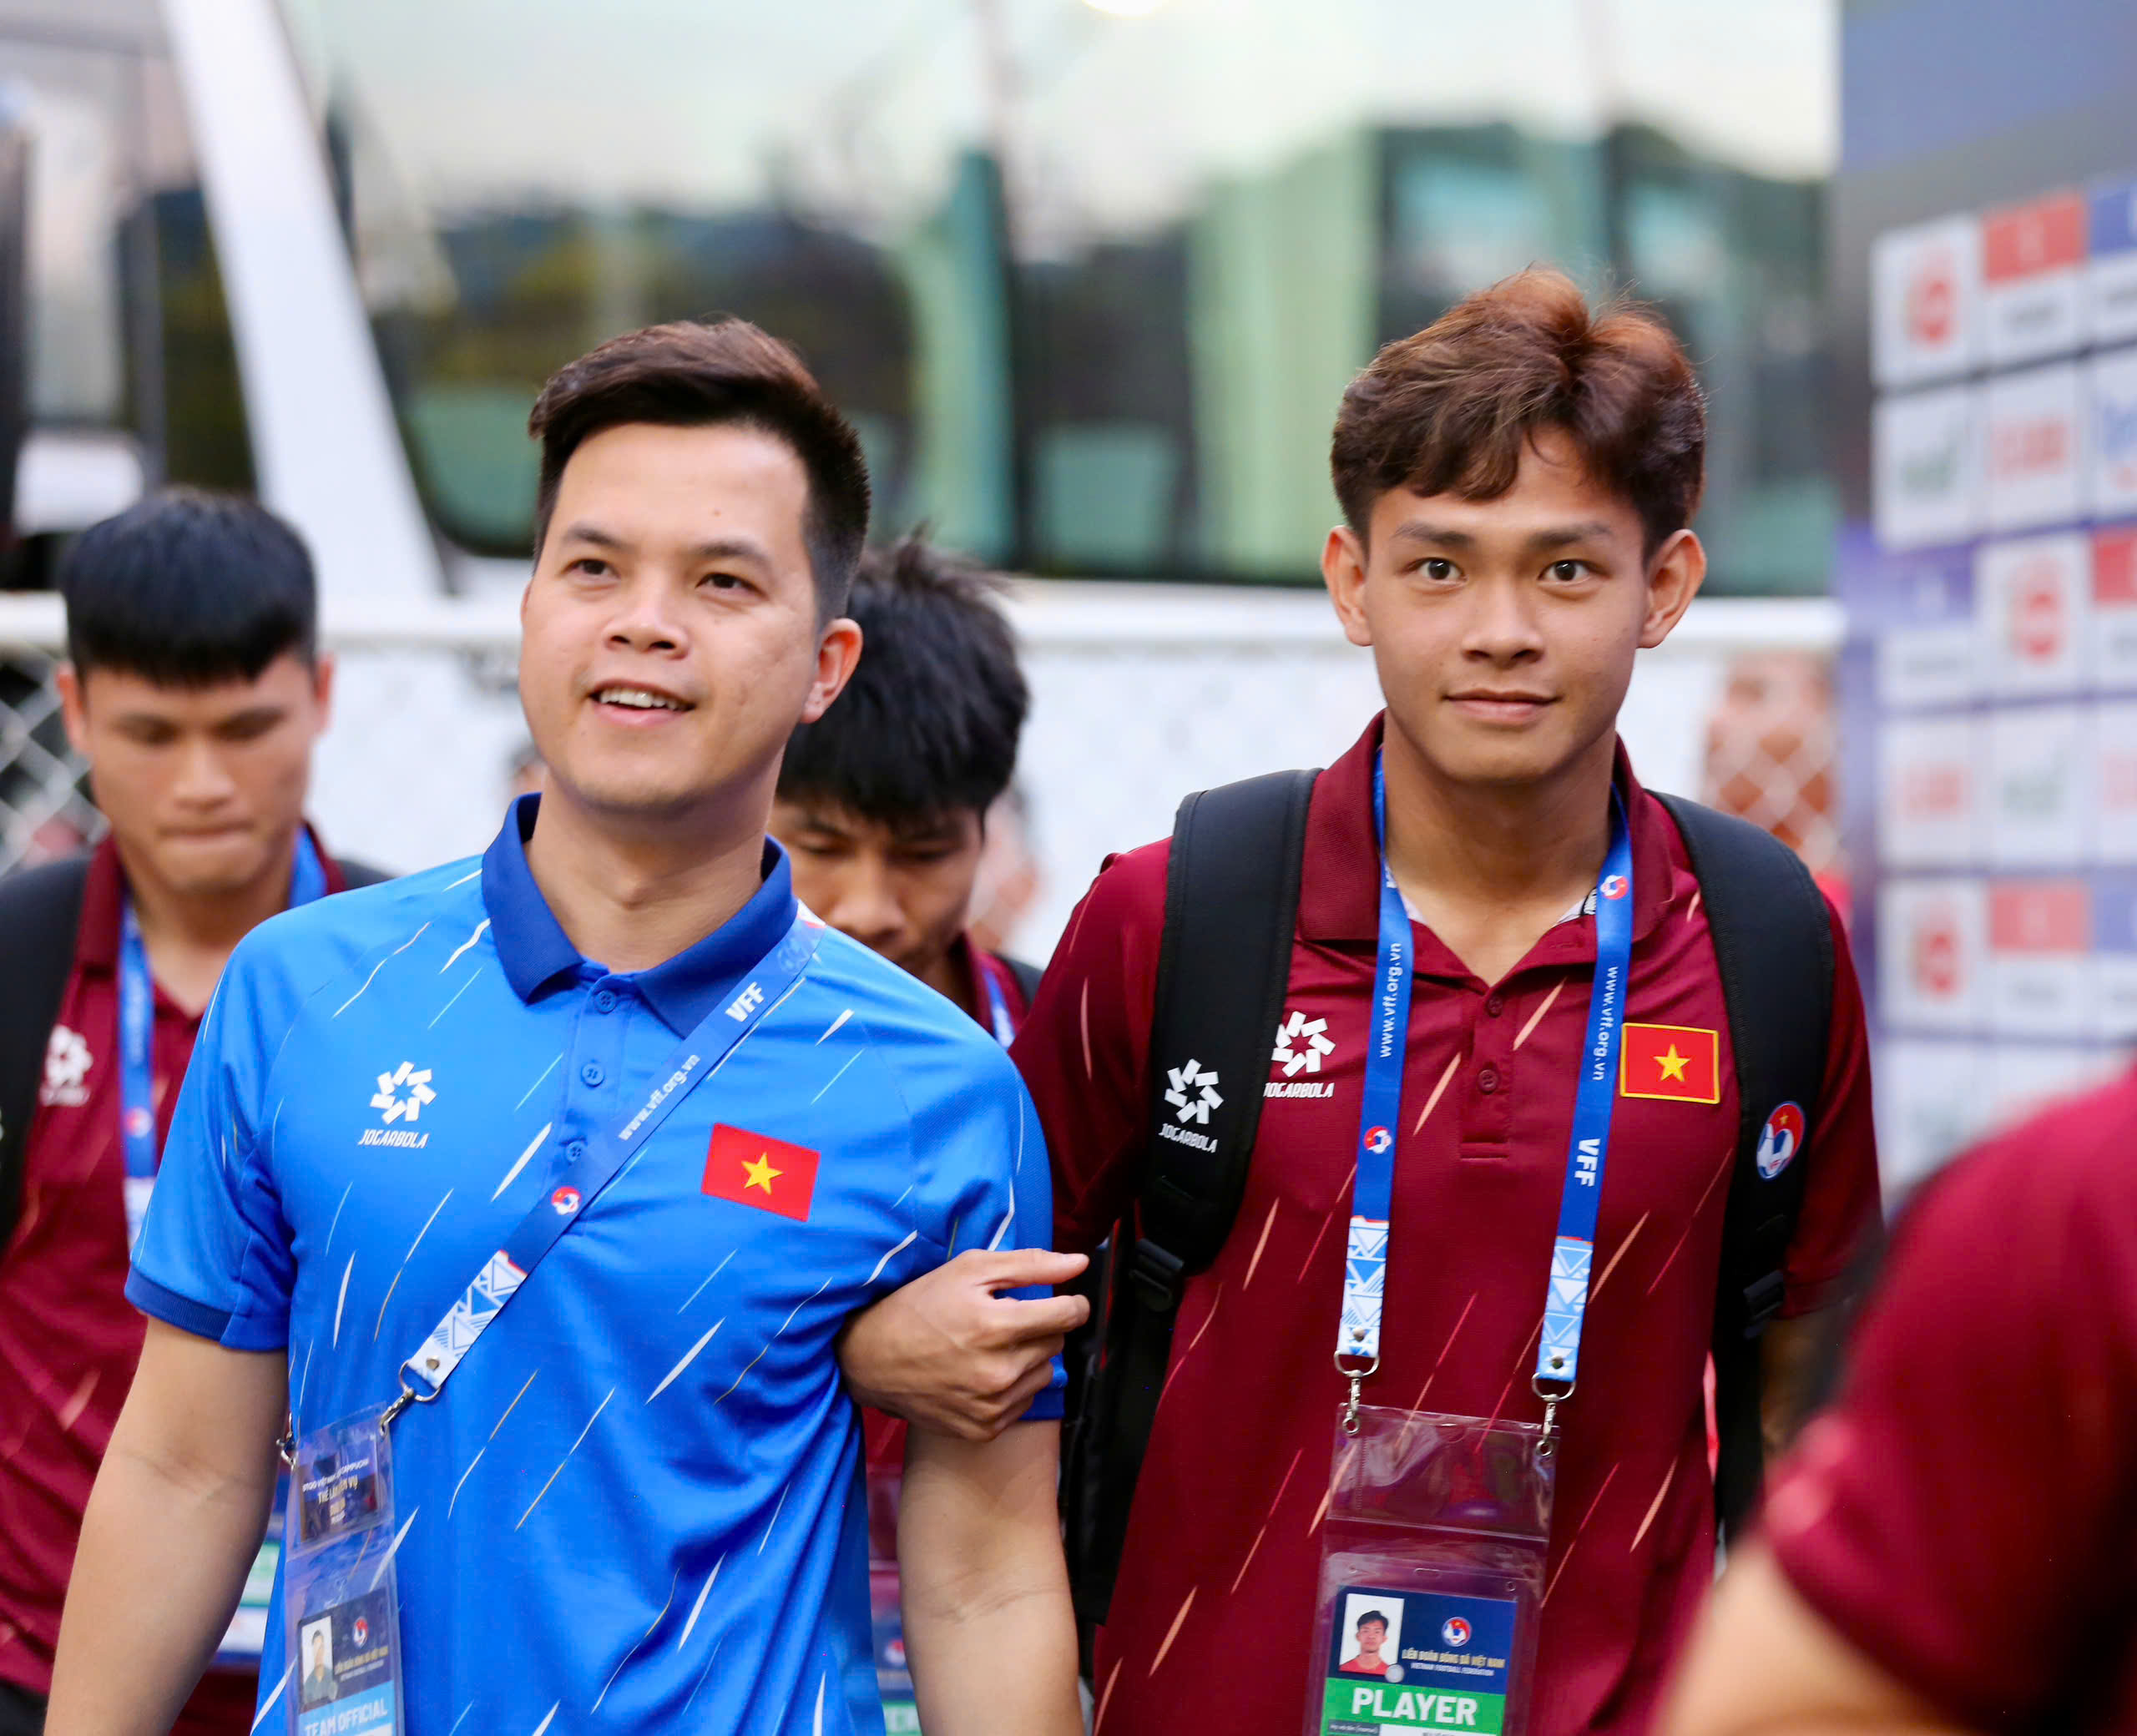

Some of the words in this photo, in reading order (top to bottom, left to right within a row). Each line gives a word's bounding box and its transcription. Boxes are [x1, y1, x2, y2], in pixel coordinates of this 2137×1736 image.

[725, 982, 765, 1022] VFF
[1380, 942, 1403, 1058] www.vff.org.vn
[1593, 966, 1619, 1081] www.vff.org.vn
[618, 1054, 700, 1141] www.vff.org.vn
[1263, 1082, 1335, 1098] JOGARBOLA
[357, 1128, 429, 1148] JOGARBOLA
[1158, 1123, 1219, 1153] JOGARBOLA
[1574, 1138, 1600, 1188] VFF
[306, 1715, 336, 1736] TEAM
[338, 1698, 387, 1731] OFFICIAL
[1351, 1687, 1478, 1726] PLAYER
